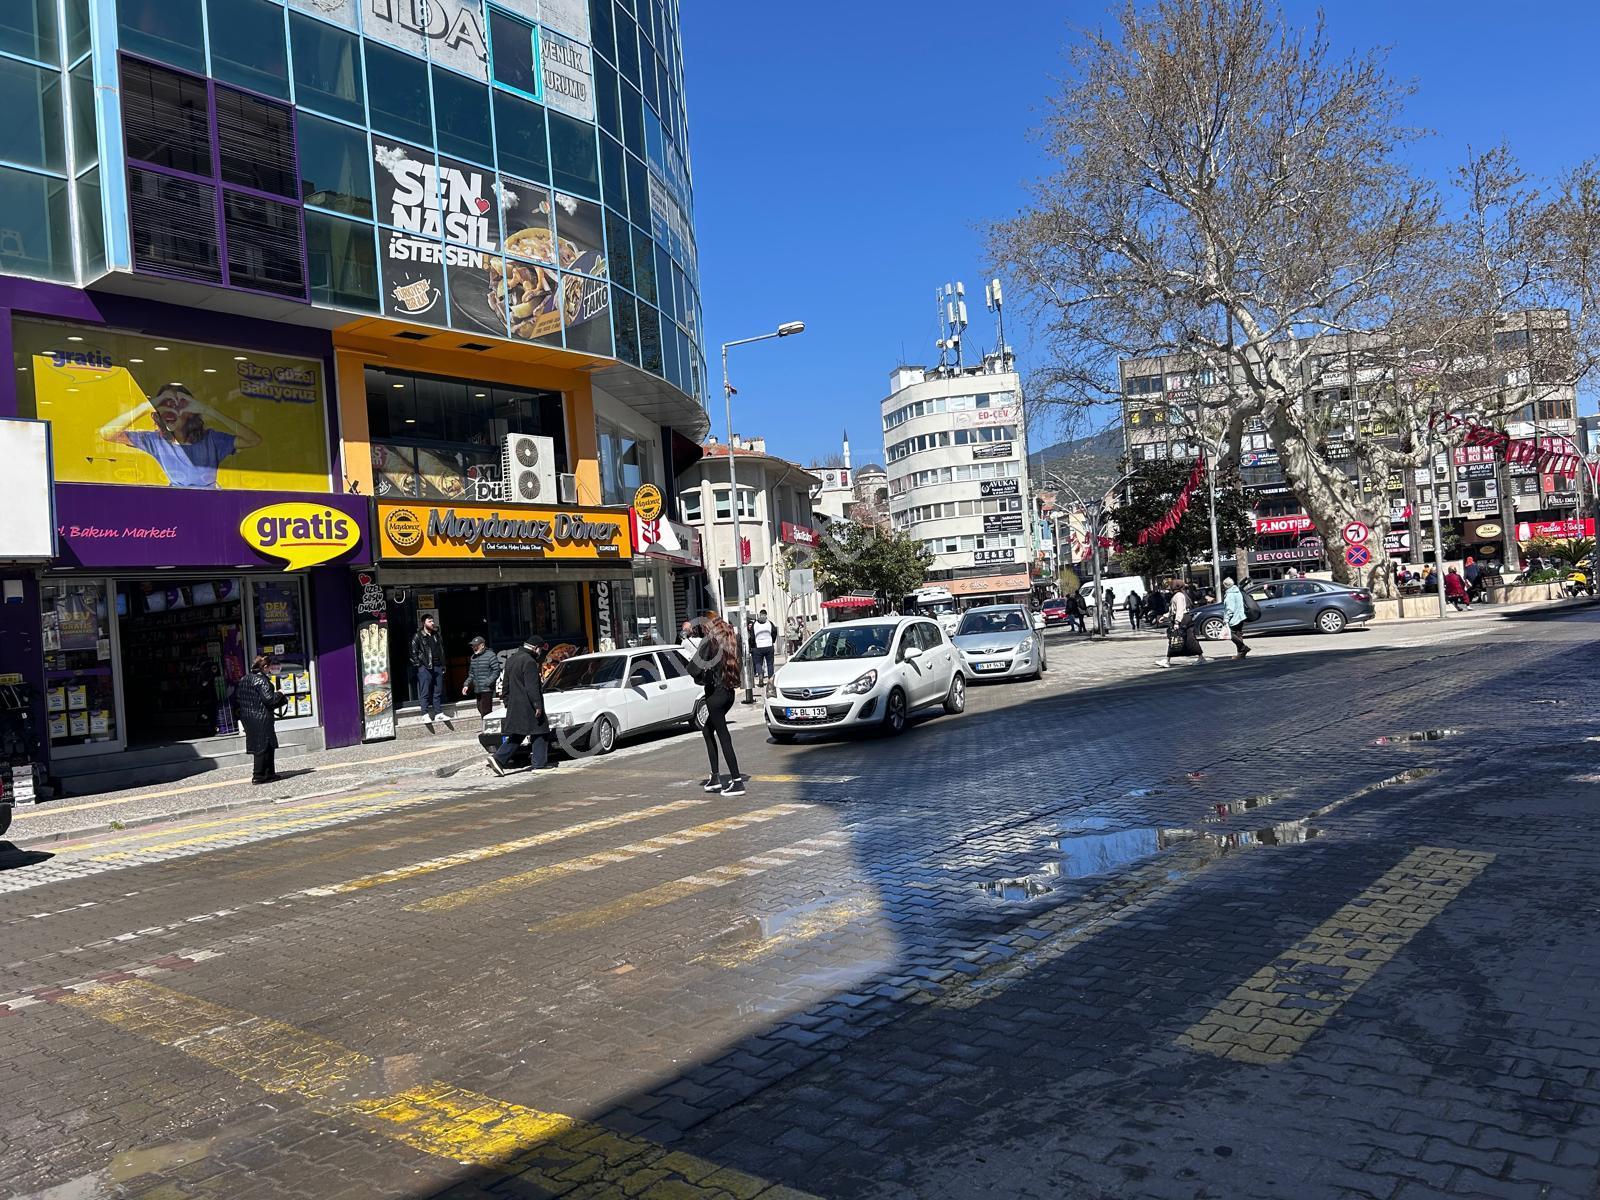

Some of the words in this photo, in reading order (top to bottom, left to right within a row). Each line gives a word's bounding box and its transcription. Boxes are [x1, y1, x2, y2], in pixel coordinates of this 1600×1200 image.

[392, 159, 482, 217] SEN
[391, 203, 496, 252] NASIL
[52, 350, 113, 368] gratis
[238, 361, 272, 379] Size
[989, 479, 1017, 488] AVUKAT
[635, 498, 661, 508] Maydonoz
[70, 526, 119, 538] Bakım
[121, 525, 178, 538] Marketi
[257, 510, 349, 547] gratis
[389, 522, 420, 532] Maydonoz
[428, 508, 553, 545] Maydonoz
[554, 513, 617, 540] Döner
[266, 602, 288, 610] DEV
[63, 611, 91, 621] DEV
[813, 707, 825, 716] 135
[366, 722, 394, 738] DENE!
